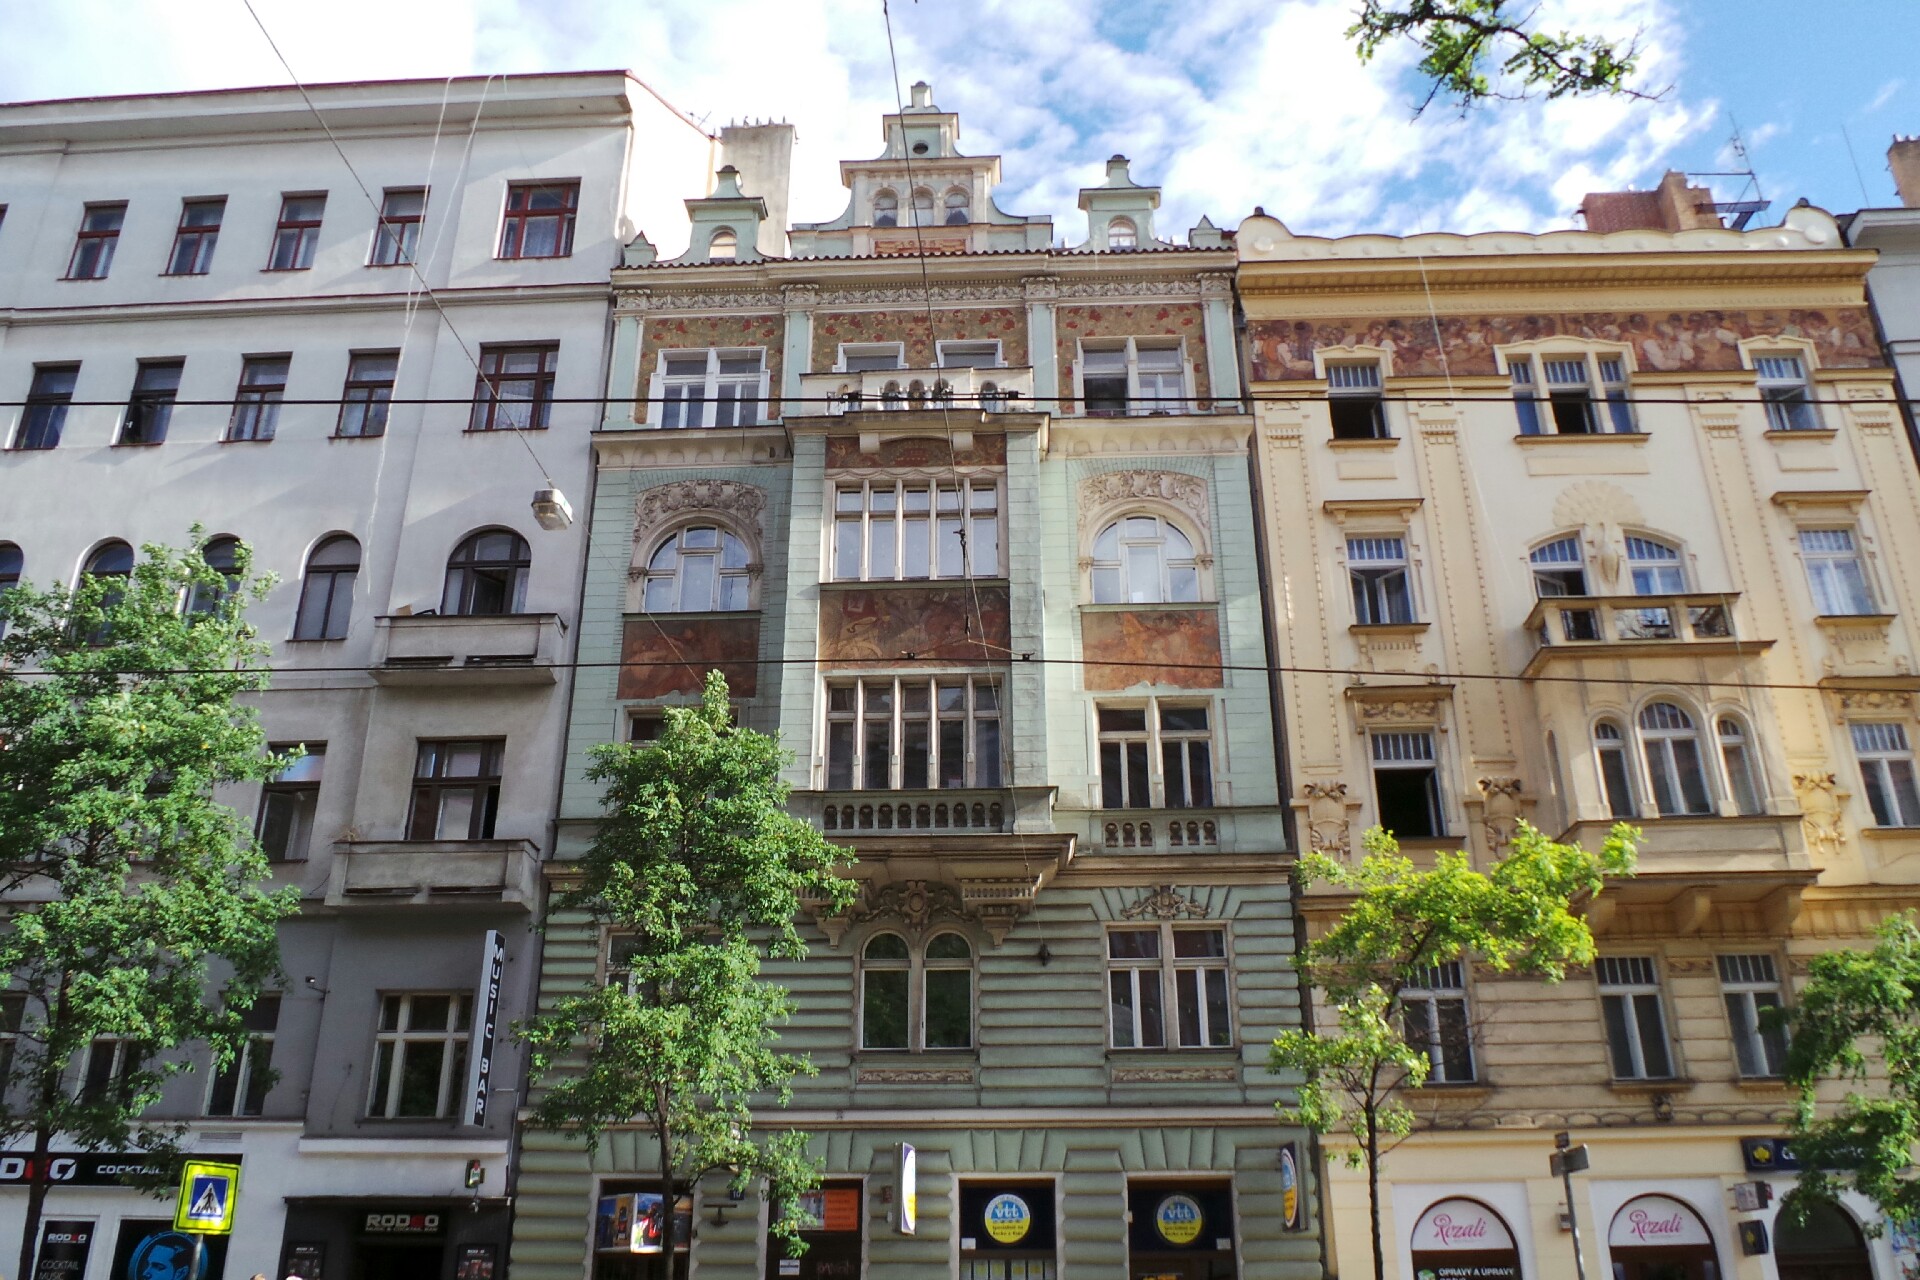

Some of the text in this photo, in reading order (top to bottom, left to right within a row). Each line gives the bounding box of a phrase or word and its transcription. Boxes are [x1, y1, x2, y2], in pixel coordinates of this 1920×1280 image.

[475, 944, 504, 1116] MUSIC BAR
[995, 1202, 1019, 1219] vtt
[1167, 1203, 1191, 1219] vtt
[1432, 1213, 1487, 1246] Rozali
[1629, 1209, 1683, 1242] Rozali
[41, 1260, 79, 1270] COCKTAIL
[1438, 1267, 1472, 1277] OPRAVY
[1473, 1268, 1480, 1276] A
